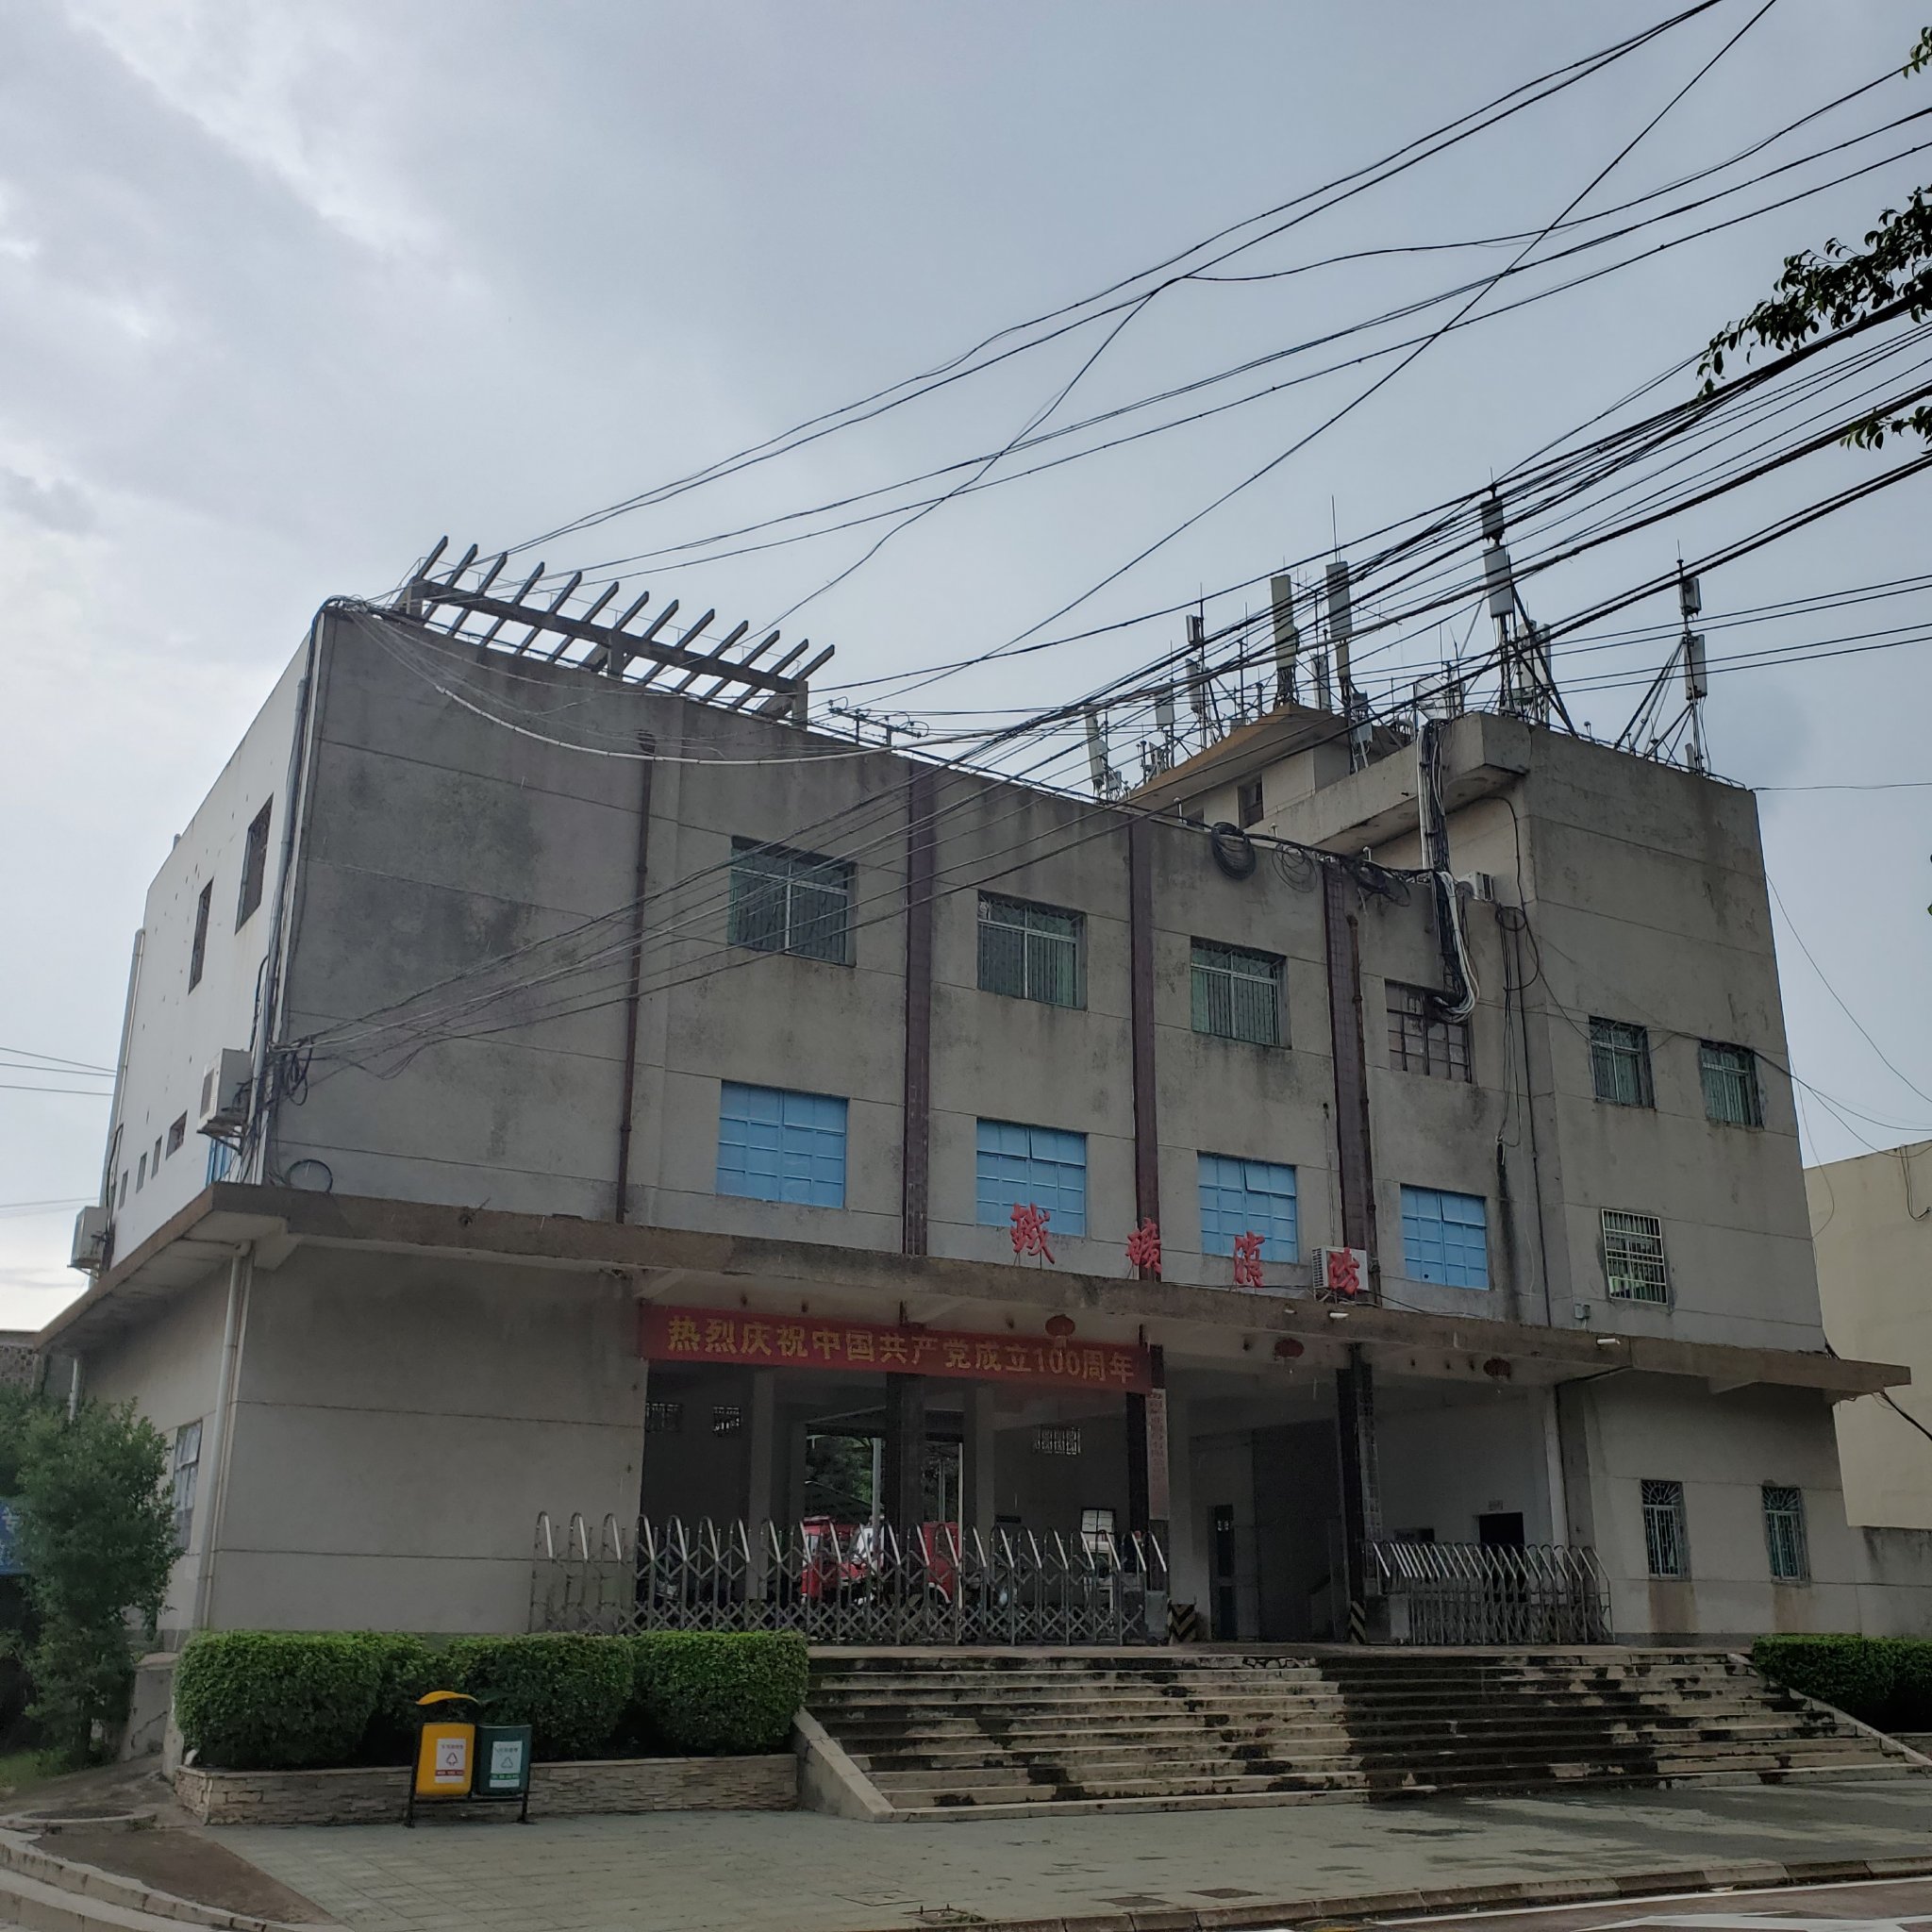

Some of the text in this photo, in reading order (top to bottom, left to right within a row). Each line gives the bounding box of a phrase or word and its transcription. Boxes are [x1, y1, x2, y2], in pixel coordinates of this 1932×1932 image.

[667, 1315, 1134, 1384] 热烈庆祝中国共产党成立100周年
